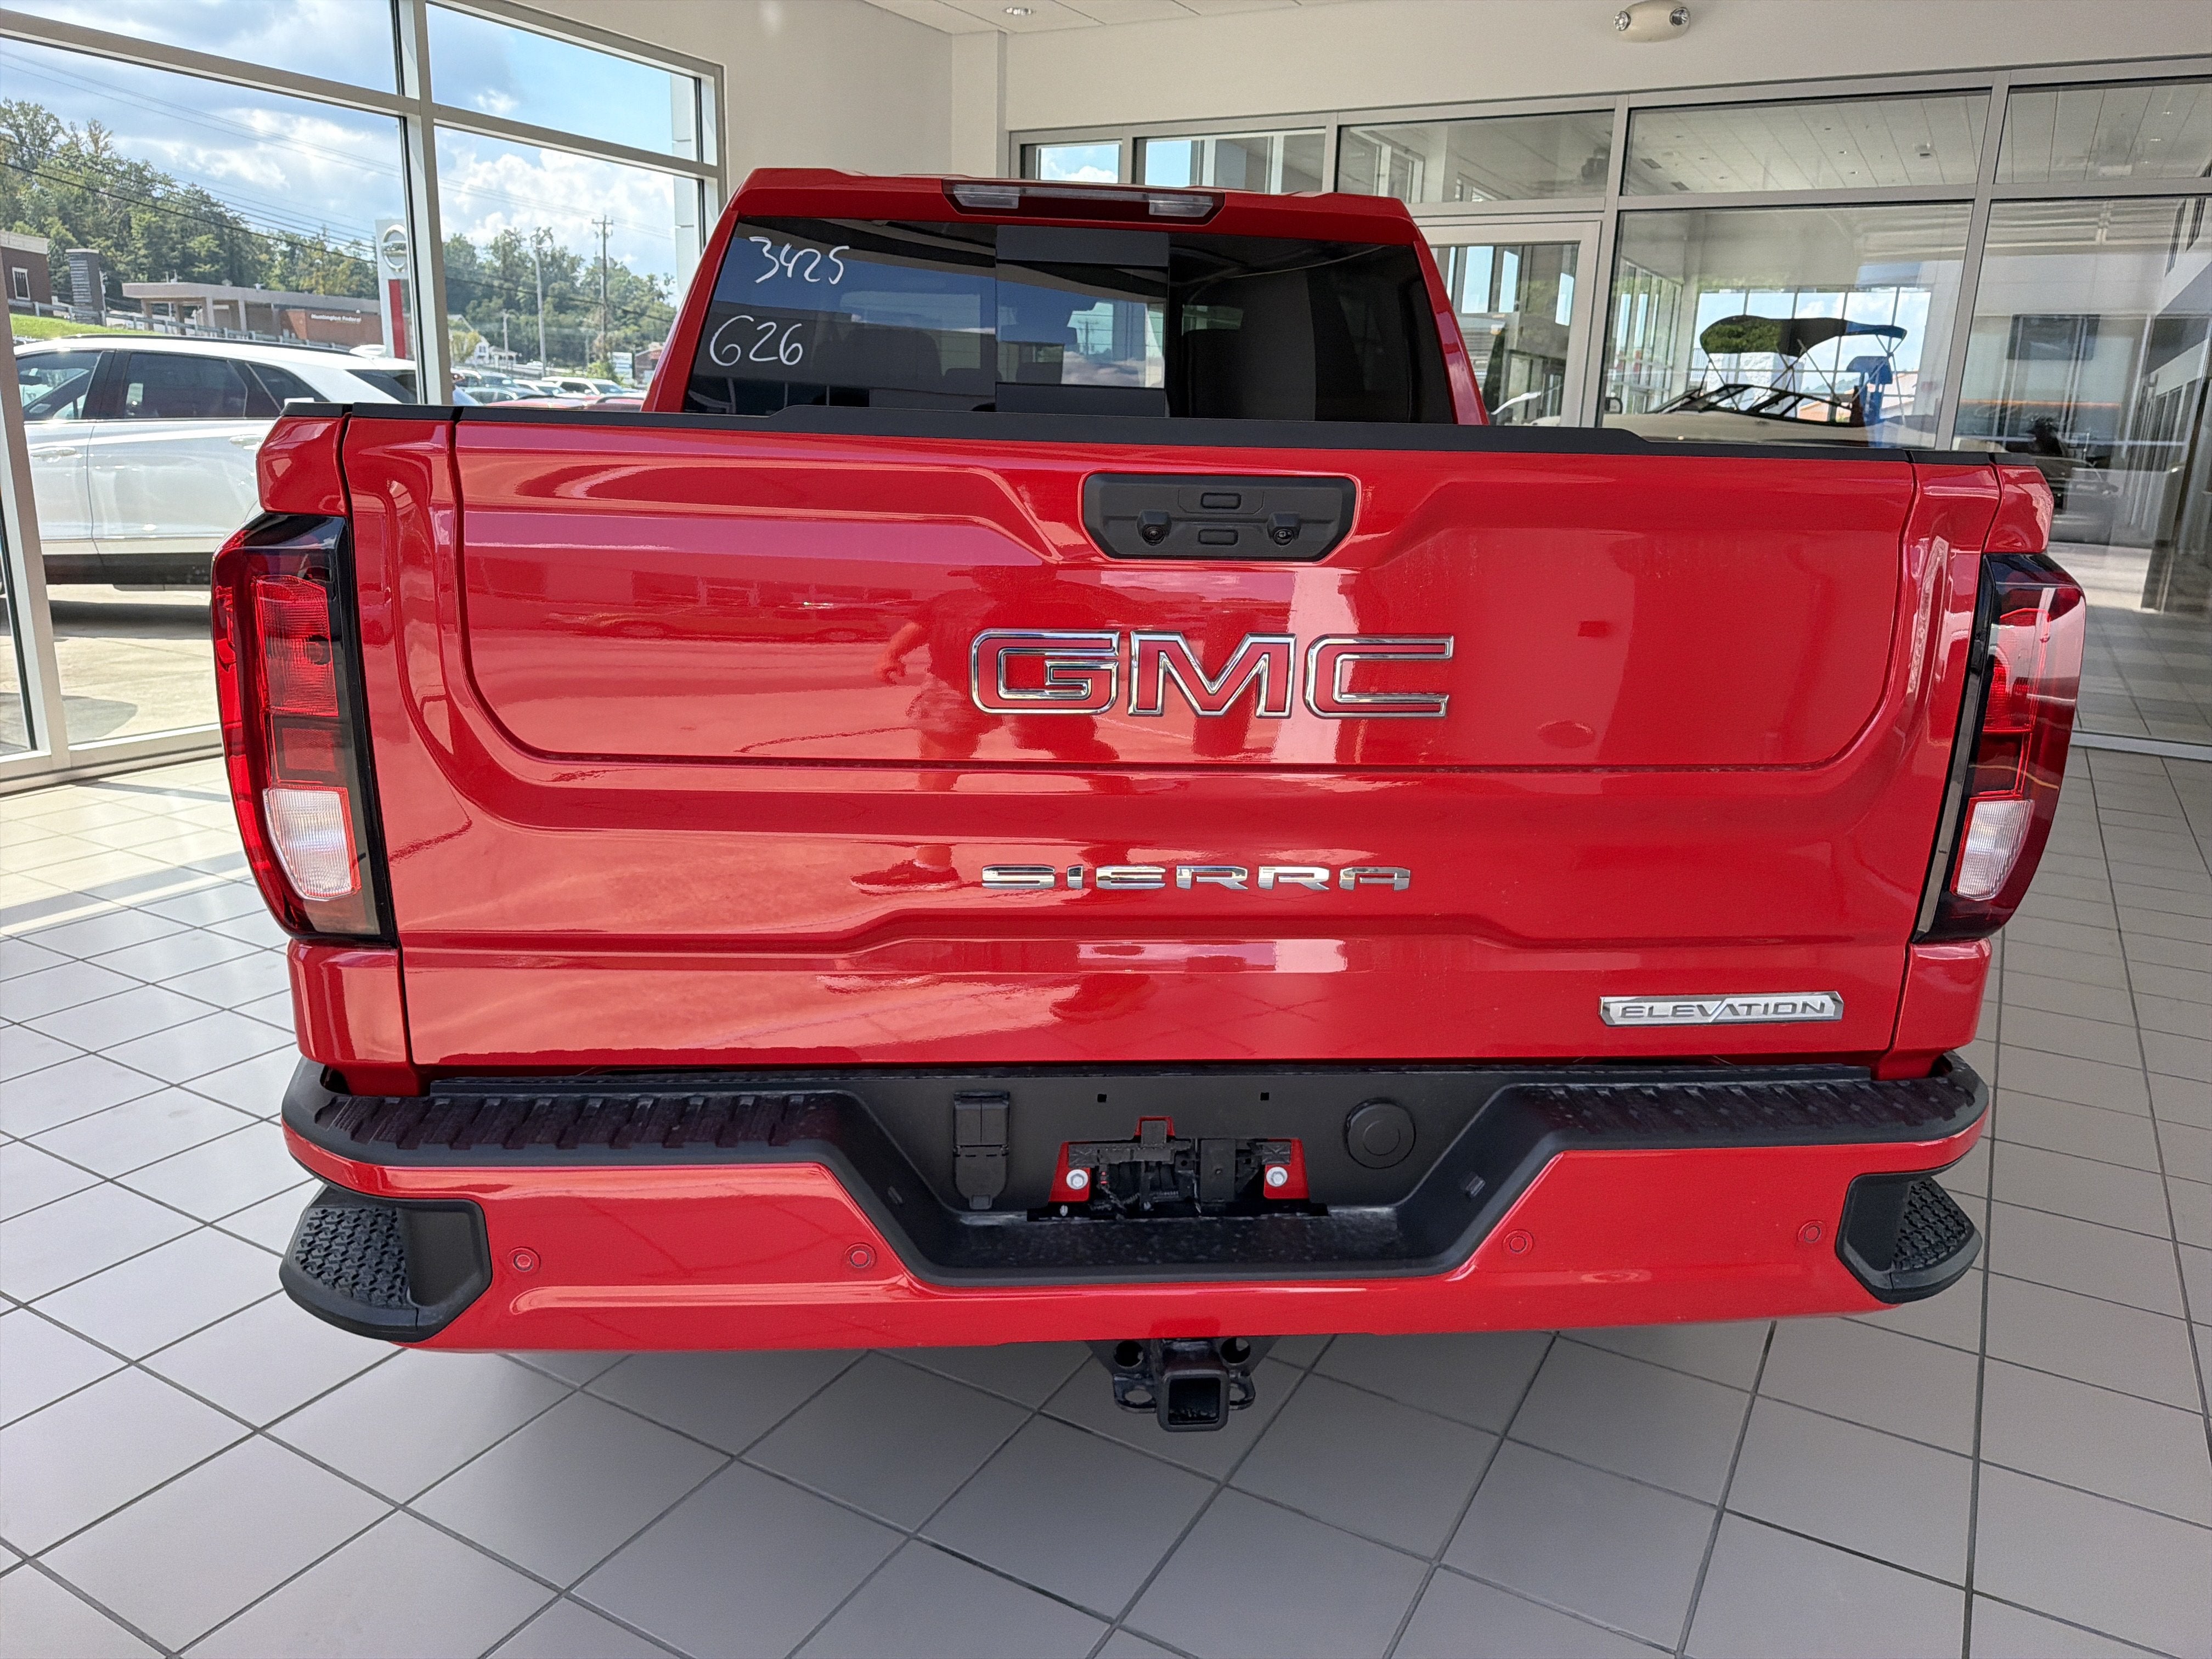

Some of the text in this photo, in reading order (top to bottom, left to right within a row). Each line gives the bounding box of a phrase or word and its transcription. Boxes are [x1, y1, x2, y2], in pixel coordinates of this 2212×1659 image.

[749, 236, 850, 284] 3425
[969, 629, 1454, 718] GMC
[981, 865, 1411, 891] SIERRA
[1619, 1000, 1826, 1020] ELEVATION
